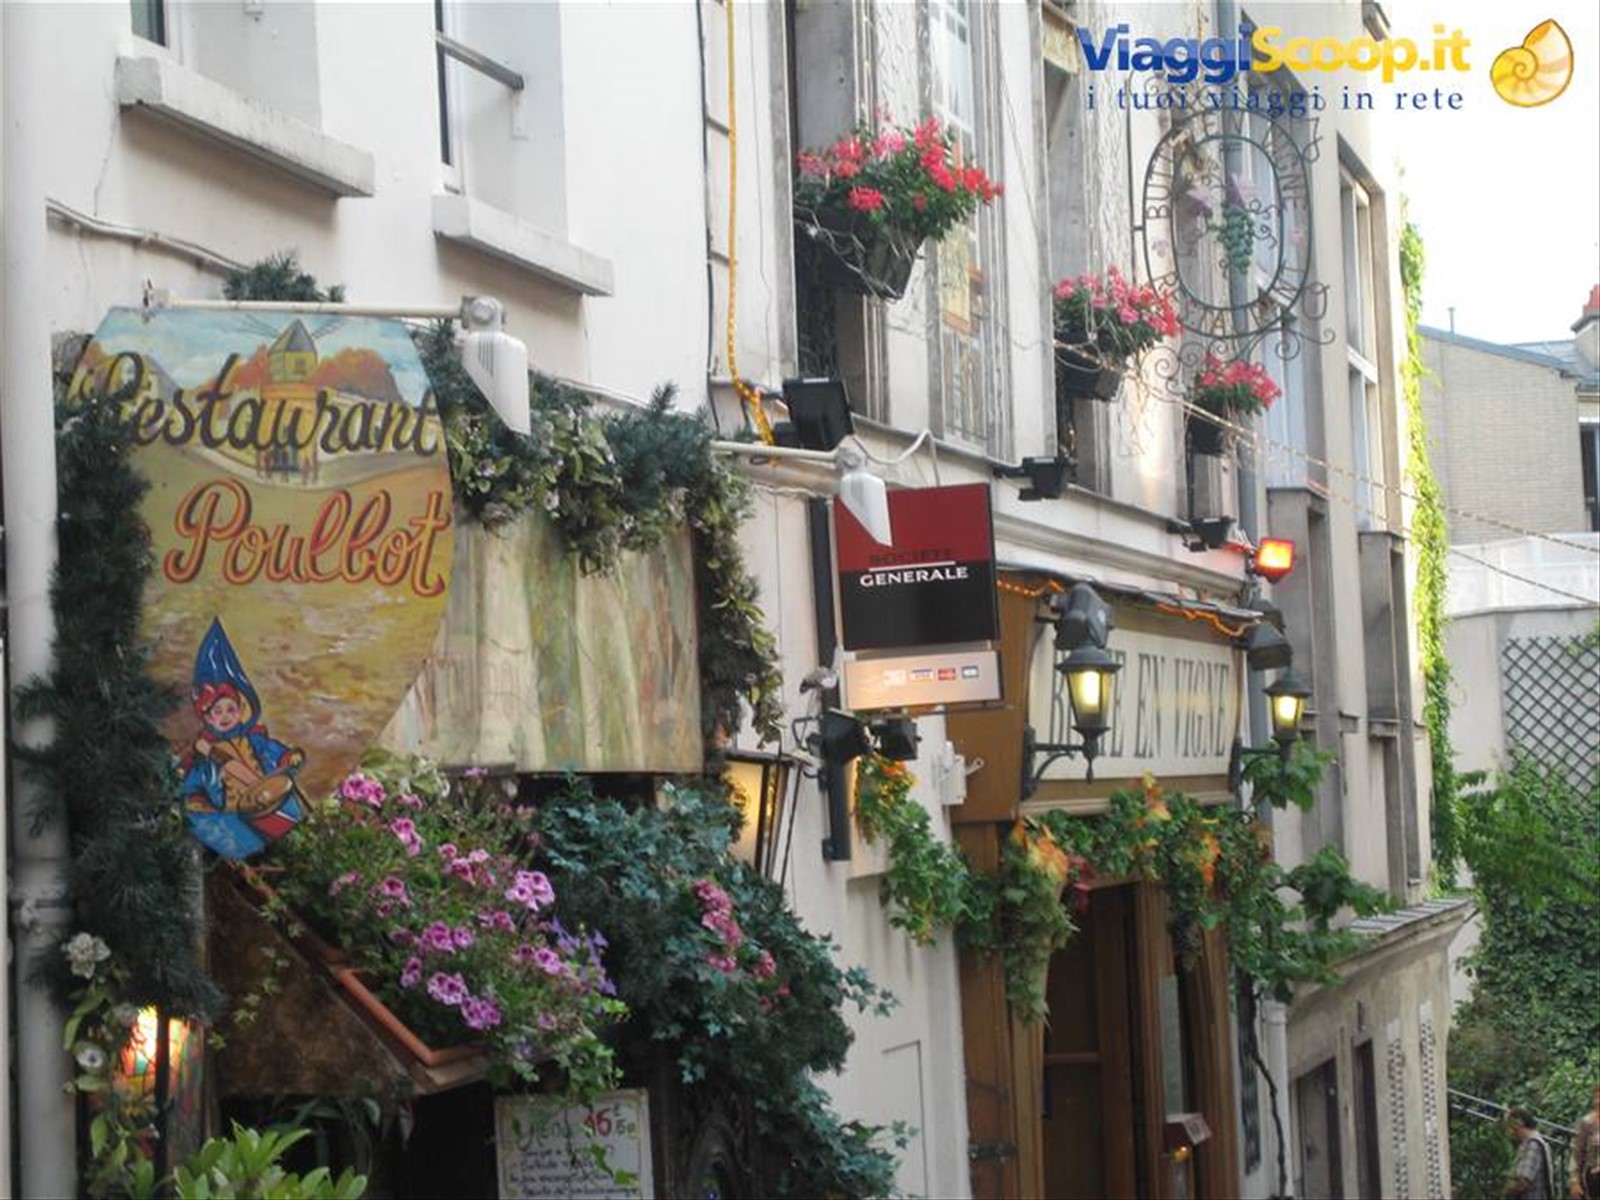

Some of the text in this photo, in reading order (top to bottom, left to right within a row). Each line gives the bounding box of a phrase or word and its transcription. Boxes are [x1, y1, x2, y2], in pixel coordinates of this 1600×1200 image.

[164, 477, 450, 597] Poulbot
[859, 566, 969, 588] GENERALE
[1133, 653, 1165, 758] EN
[1174, 658, 1230, 758] VIGNE
